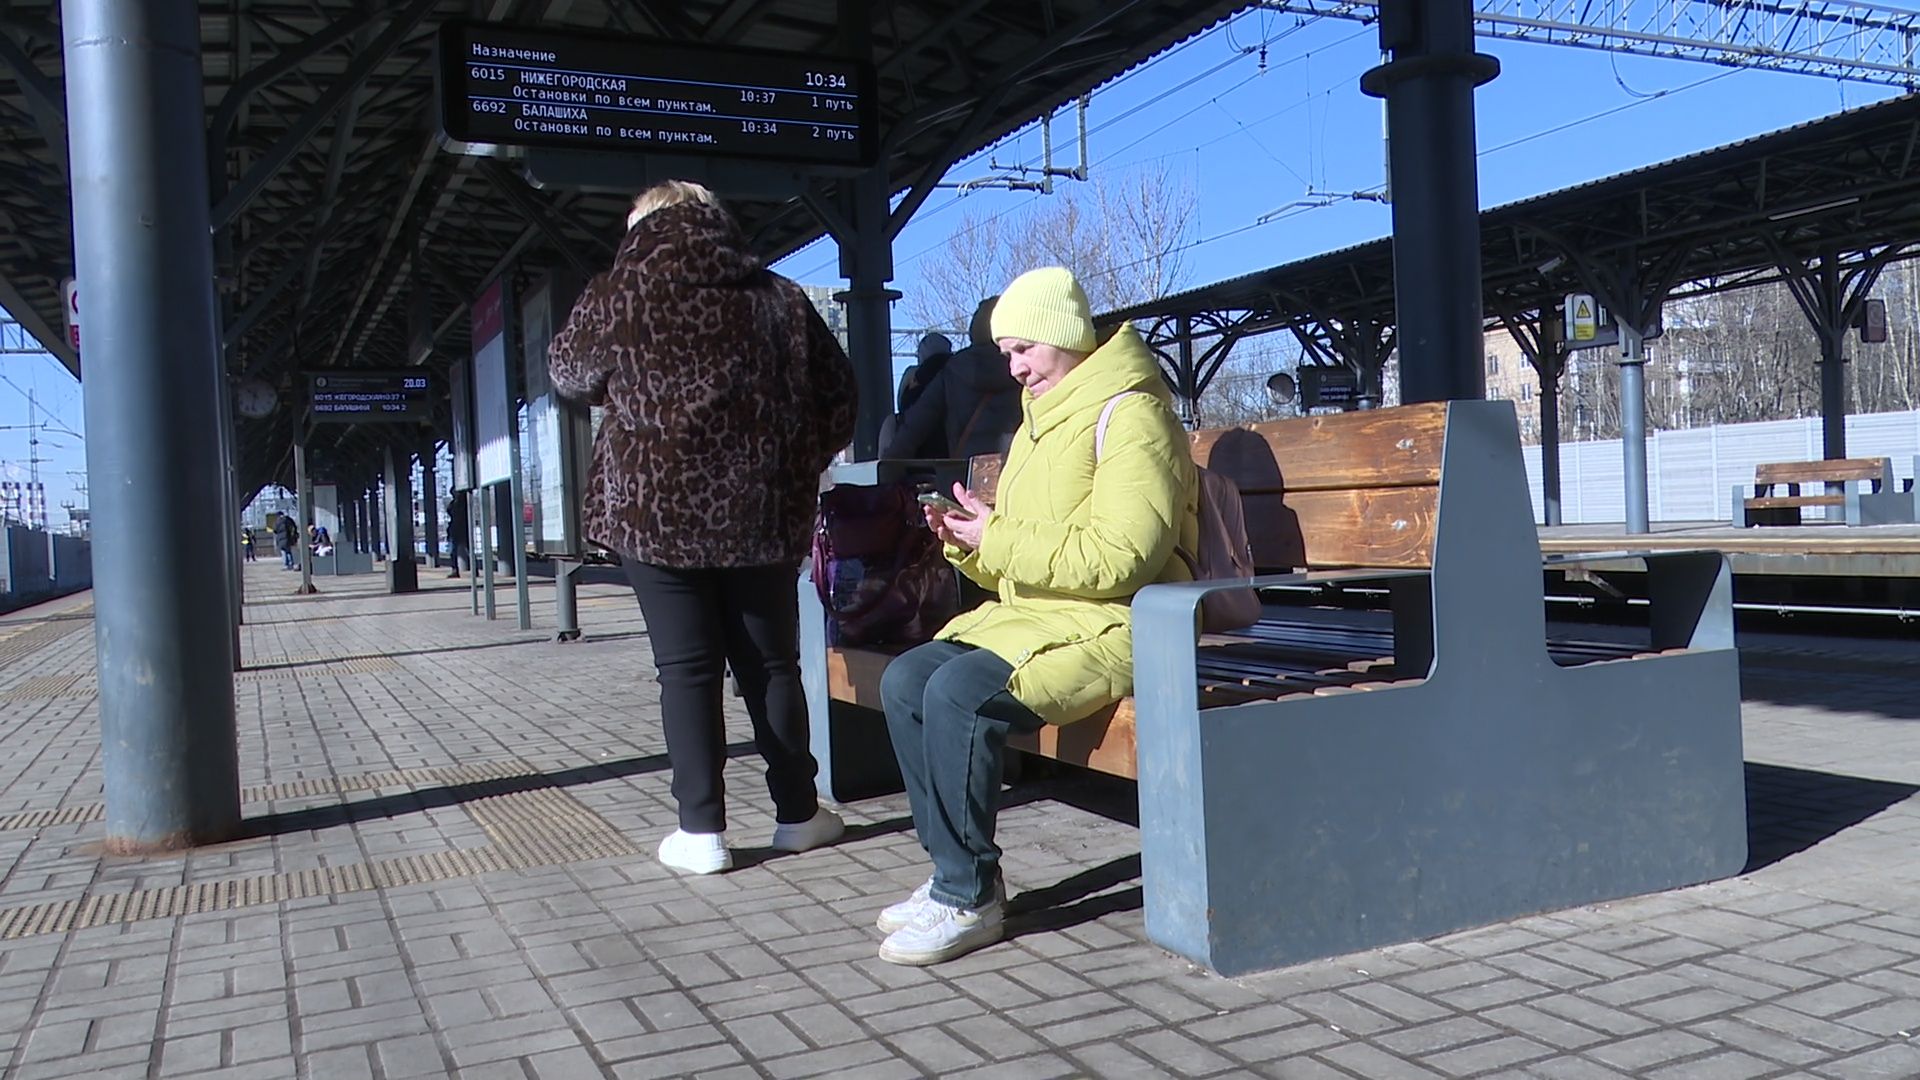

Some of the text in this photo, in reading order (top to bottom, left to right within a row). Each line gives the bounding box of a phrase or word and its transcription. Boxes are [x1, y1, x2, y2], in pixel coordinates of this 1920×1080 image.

[472, 43, 556, 61] Назначение
[471, 67, 854, 113] 6015 НИЖЕГОРОДСКАЯ 10:37 1 путь
[805, 72, 847, 88] 10:34
[513, 86, 717, 113] Остановки по всем пунктам.
[472, 100, 855, 143] 6692 БАЛАШИХА 10:34 2 путь
[514, 117, 719, 144] Остановки по всем пунктам.
[403, 379, 426, 388] 20.03
